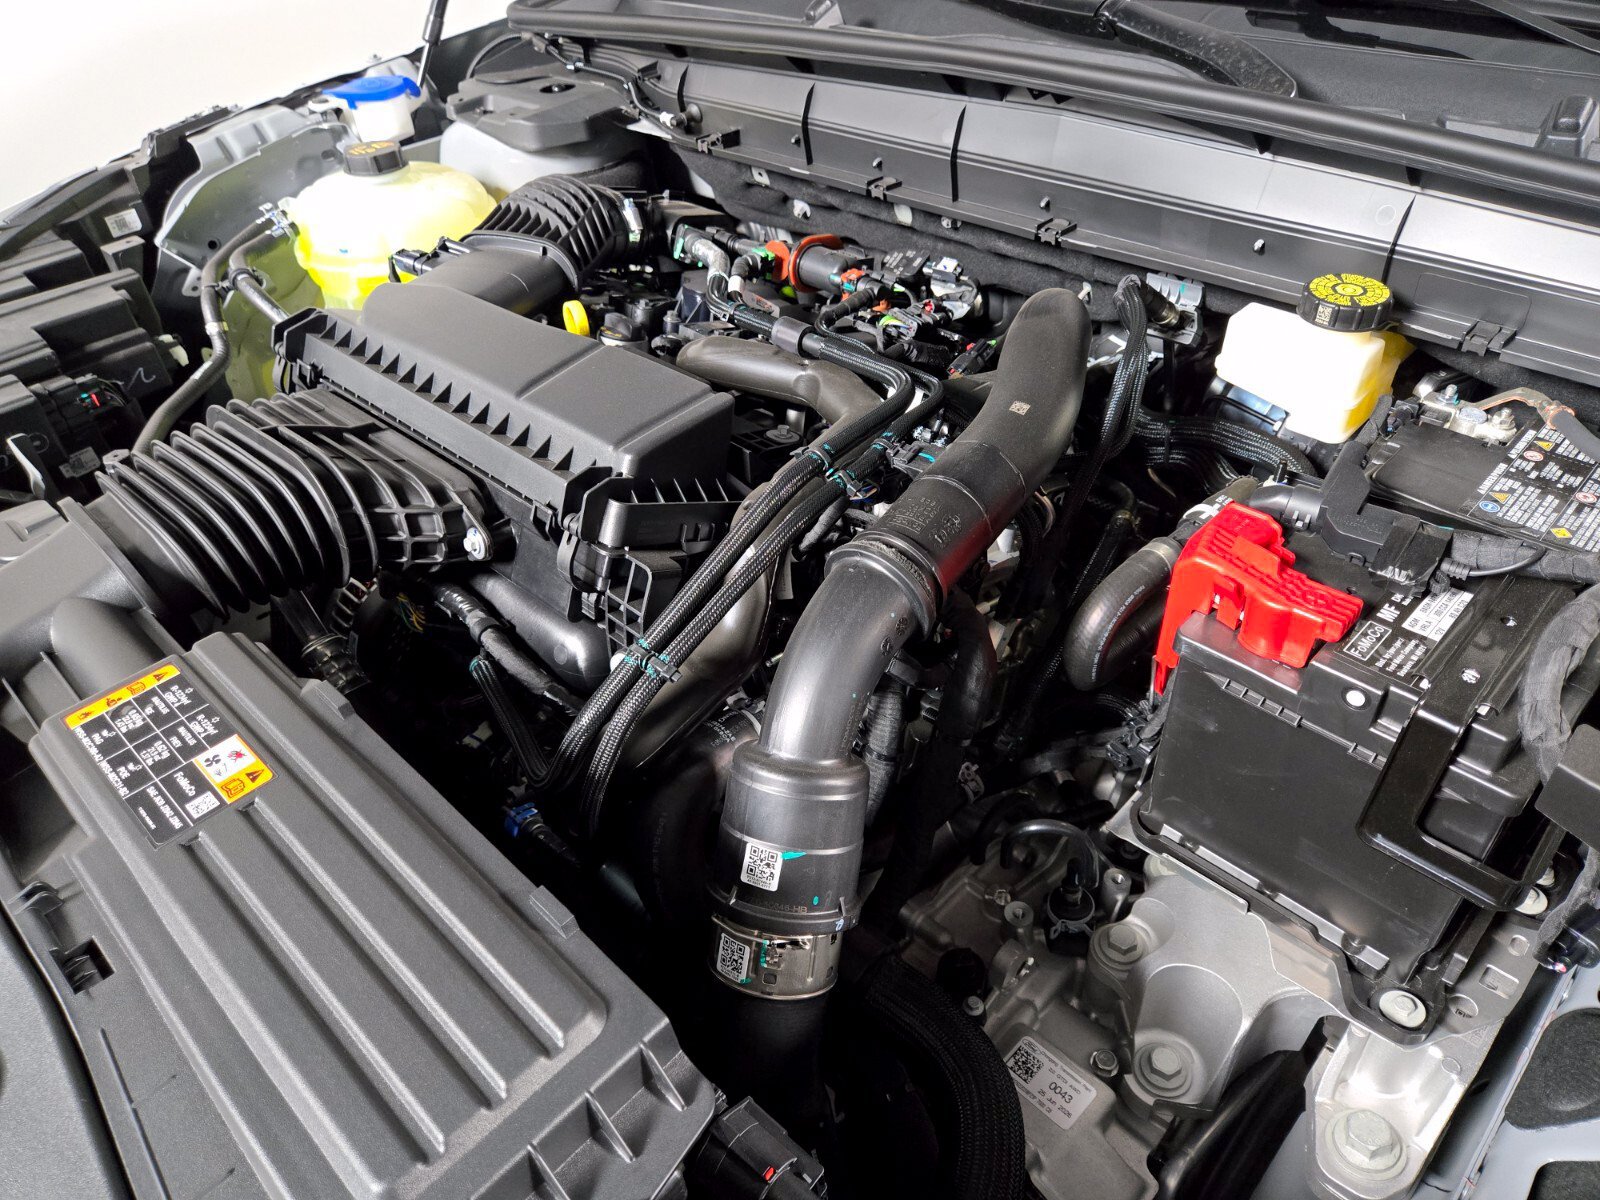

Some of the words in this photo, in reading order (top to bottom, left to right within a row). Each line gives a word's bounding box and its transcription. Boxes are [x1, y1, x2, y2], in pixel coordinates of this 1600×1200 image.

[1375, 602, 1404, 622] MF
[1348, 624, 1386, 656] FoMoCo
[1432, 626, 1446, 636] 12V
[163, 690, 178, 704] GWP
[168, 684, 191, 705] R-1234yf
[150, 695, 170, 714] NAUTILUS
[189, 720, 205, 734] GWP
[194, 713, 218, 736] R-1234yf
[90, 732, 104, 745] PAG
[176, 725, 197, 746] NAUTILUS
[115, 766, 130, 780] POE
[145, 785, 159, 797] SAE
[172, 770, 198, 797] FoMoCo
[1037, 1087, 1046, 1097] 25
[1045, 1094, 1058, 1106] Jun
[1046, 1080, 1074, 1104] 0043
[1067, 1082, 1082, 1095] AWD
